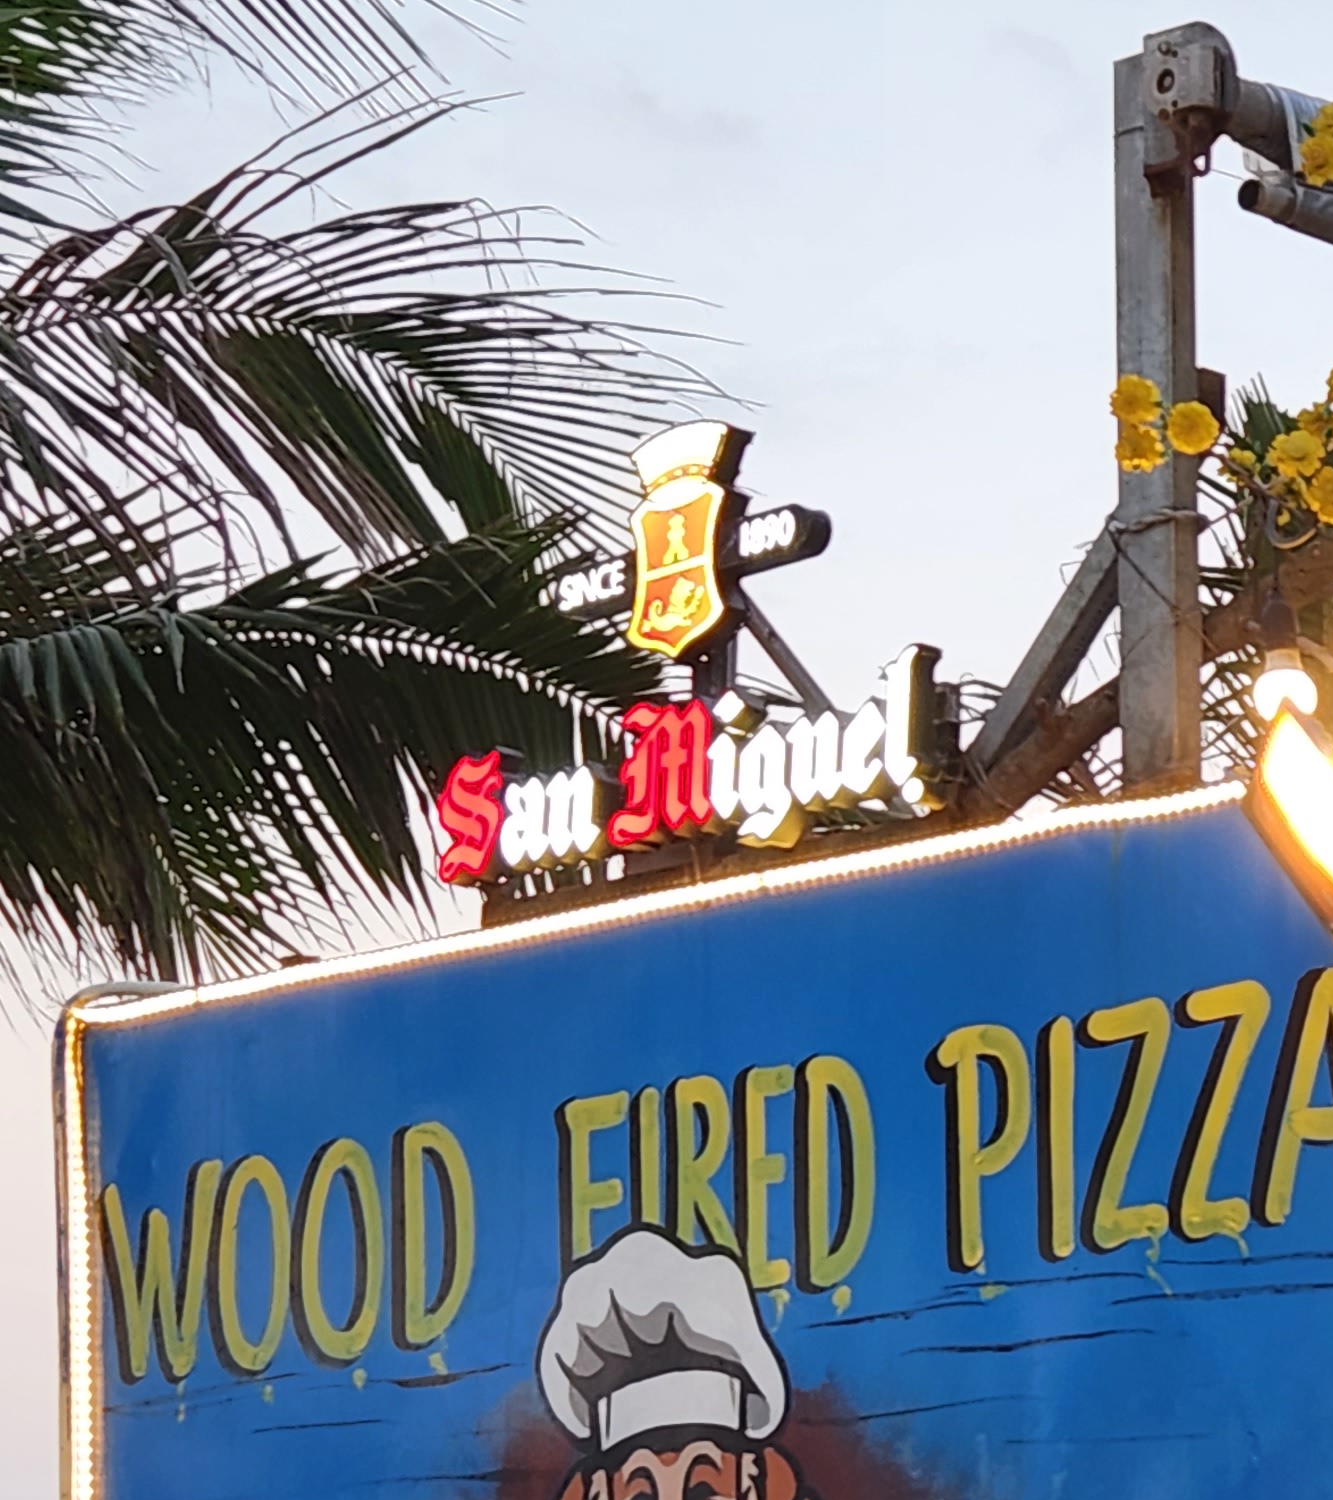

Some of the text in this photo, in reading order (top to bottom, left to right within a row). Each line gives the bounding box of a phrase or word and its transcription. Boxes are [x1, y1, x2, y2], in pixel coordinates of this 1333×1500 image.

[557, 508, 796, 613] SINCE 1890
[437, 642, 928, 883] San Miguel
[100, 1120, 477, 1385] WOOD
[555, 1052, 877, 1292] FIRED
